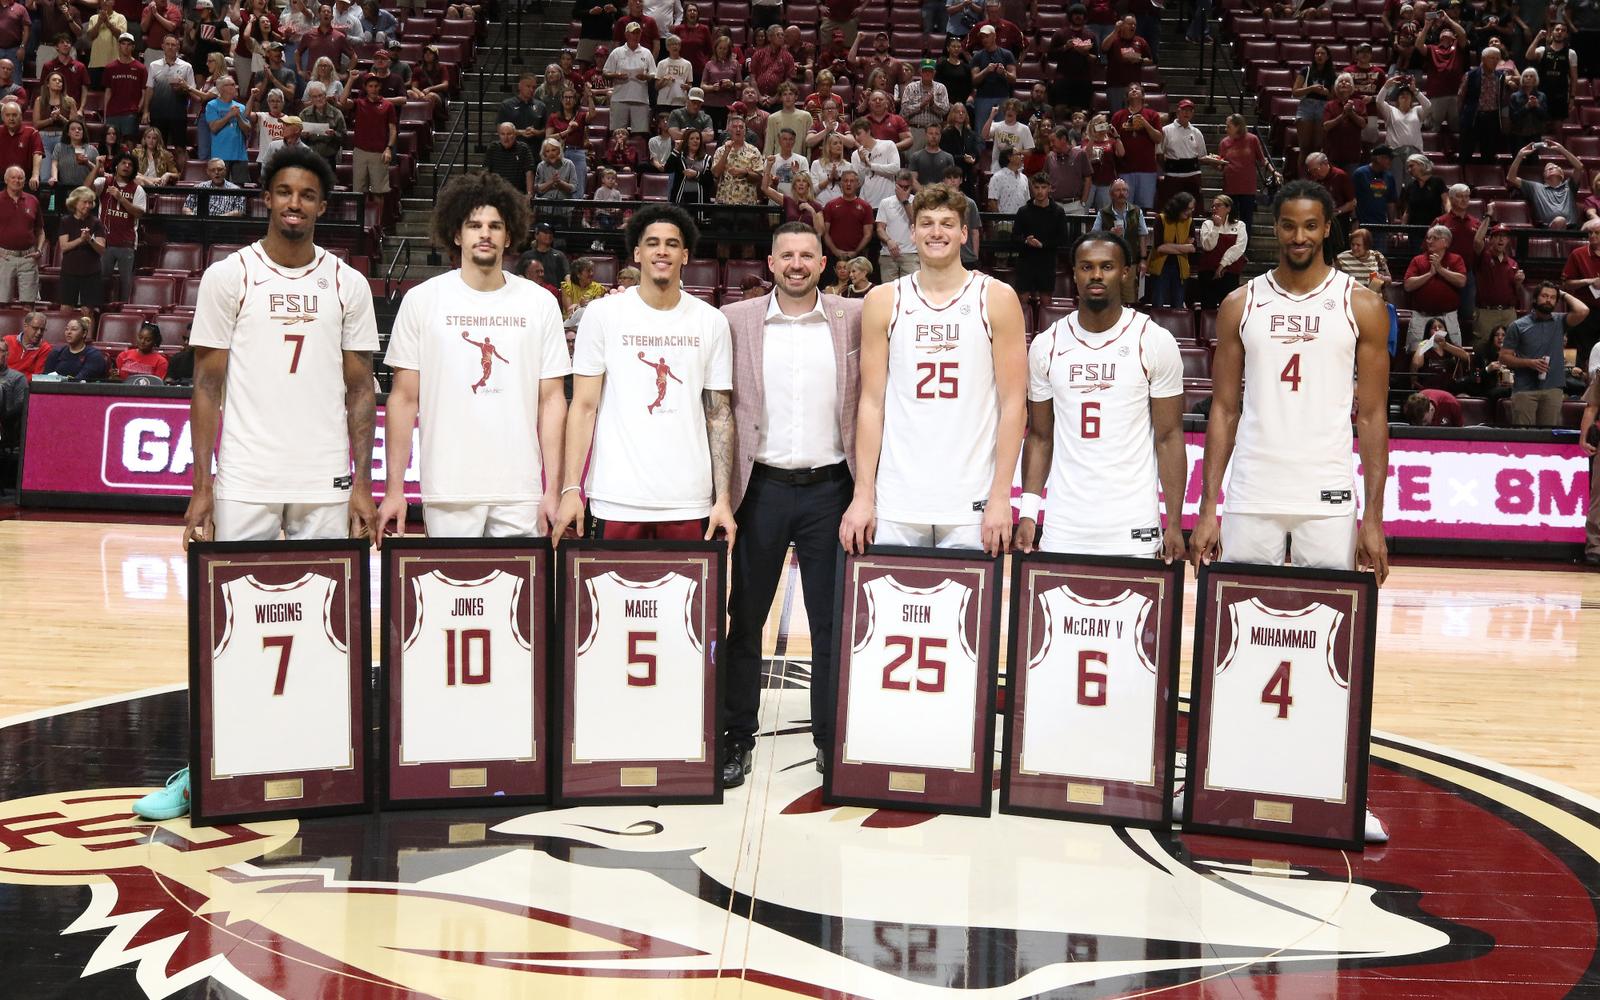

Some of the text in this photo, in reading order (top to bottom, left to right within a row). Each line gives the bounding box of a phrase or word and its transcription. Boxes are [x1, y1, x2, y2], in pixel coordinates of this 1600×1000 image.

[107, 208, 129, 219] STATE
[269, 294, 318, 313] FSU
[445, 315, 527, 328] STEENMACHINE
[915, 323, 960, 342] FSU
[1270, 314, 1320, 333] FSU
[622, 334, 700, 347] STEENMACHINE
[284, 334, 305, 374] 7
[916, 362, 959, 399] 25
[1069, 363, 1116, 382] FSU
[1280, 353, 1302, 392] 4
[1081, 402, 1101, 439] 6
[255, 602, 303, 624] WIGGINS
[451, 597, 485, 617] JONES
[625, 599, 658, 618] MAGEE
[902, 603, 931, 624] STEEN
[1063, 616, 1124, 639] McCRAY V
[1250, 626, 1317, 649] MUHAMMAD
[262, 635, 294, 696] 7
[443, 628, 492, 686] 10
[627, 631, 657, 687] 5
[881, 634, 948, 693] 25
[1077, 650, 1108, 707] 6
[1260, 660, 1293, 719] 4
